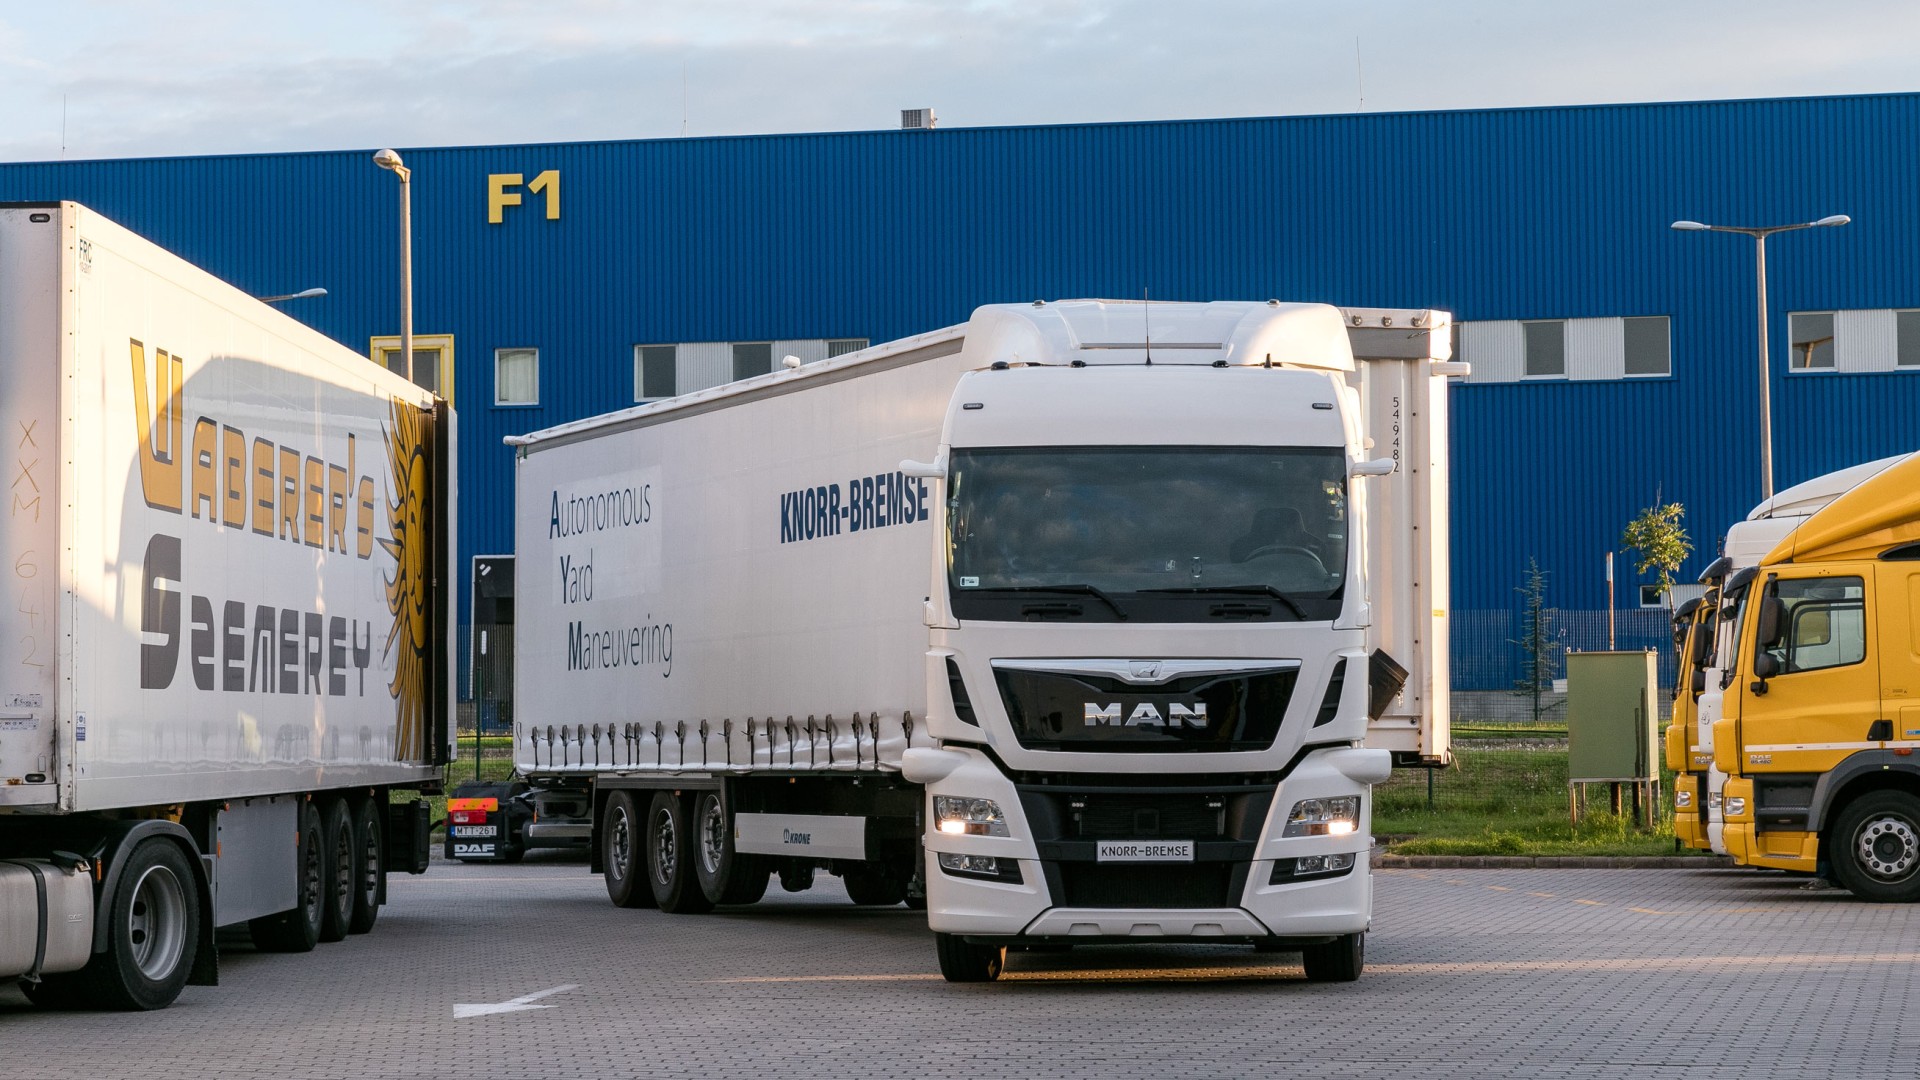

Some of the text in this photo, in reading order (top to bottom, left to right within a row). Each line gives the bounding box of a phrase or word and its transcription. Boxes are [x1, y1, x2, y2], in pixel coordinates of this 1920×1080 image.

[488, 170, 560, 224] F1
[79, 238, 92, 264] FRC
[549, 484, 651, 540] Autonomous
[780, 471, 929, 544] KNORR-BREMSE
[560, 548, 593, 604] Yard
[568, 613, 673, 679] Maneuvering
[1084, 702, 1207, 727] MAN
[456, 826, 495, 835] MTT-261
[789, 833, 811, 845] KRONE
[454, 844, 495, 853] DAF
[1101, 846, 1189, 857] KNORR-BREMSE
